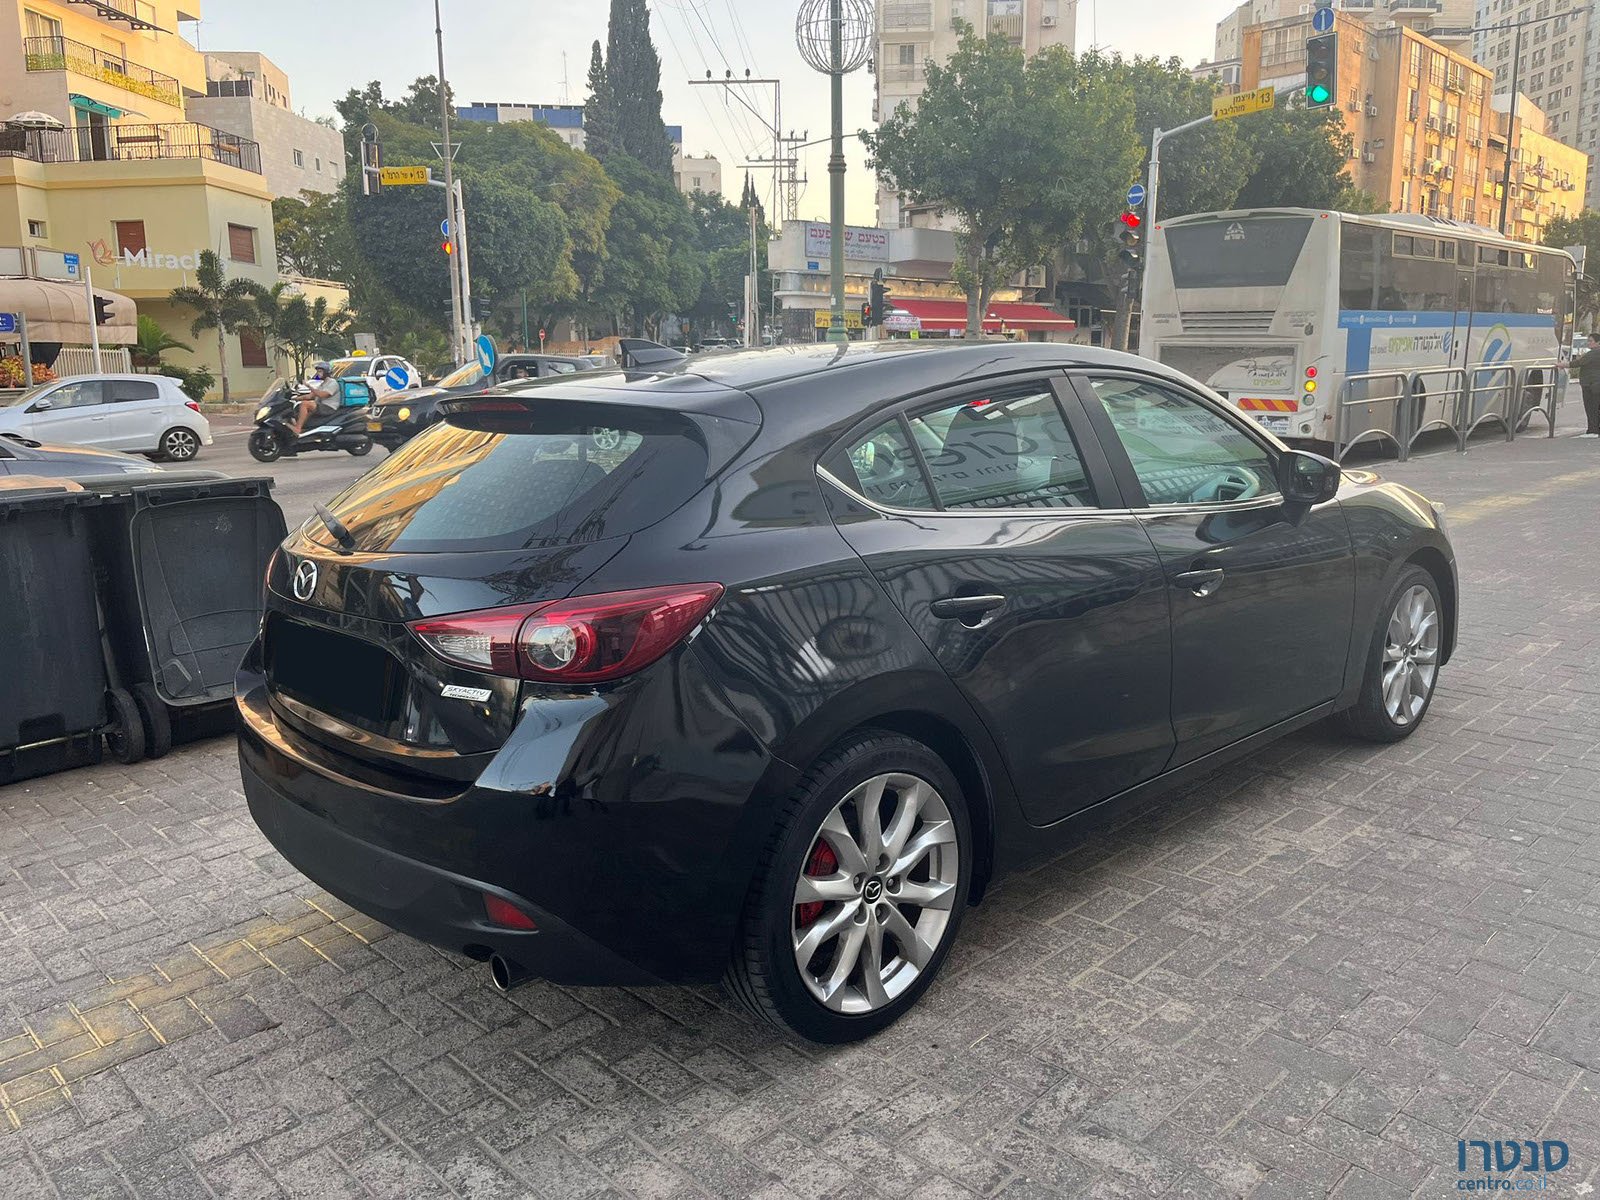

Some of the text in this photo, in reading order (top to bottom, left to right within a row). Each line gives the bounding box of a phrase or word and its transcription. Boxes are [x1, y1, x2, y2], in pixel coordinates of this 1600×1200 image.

[1261, 92, 1270, 103] 13
[416, 170, 425, 179] 13
[858, 232, 886, 245] בטעם
[448, 686, 485, 696] SKYACTIV
